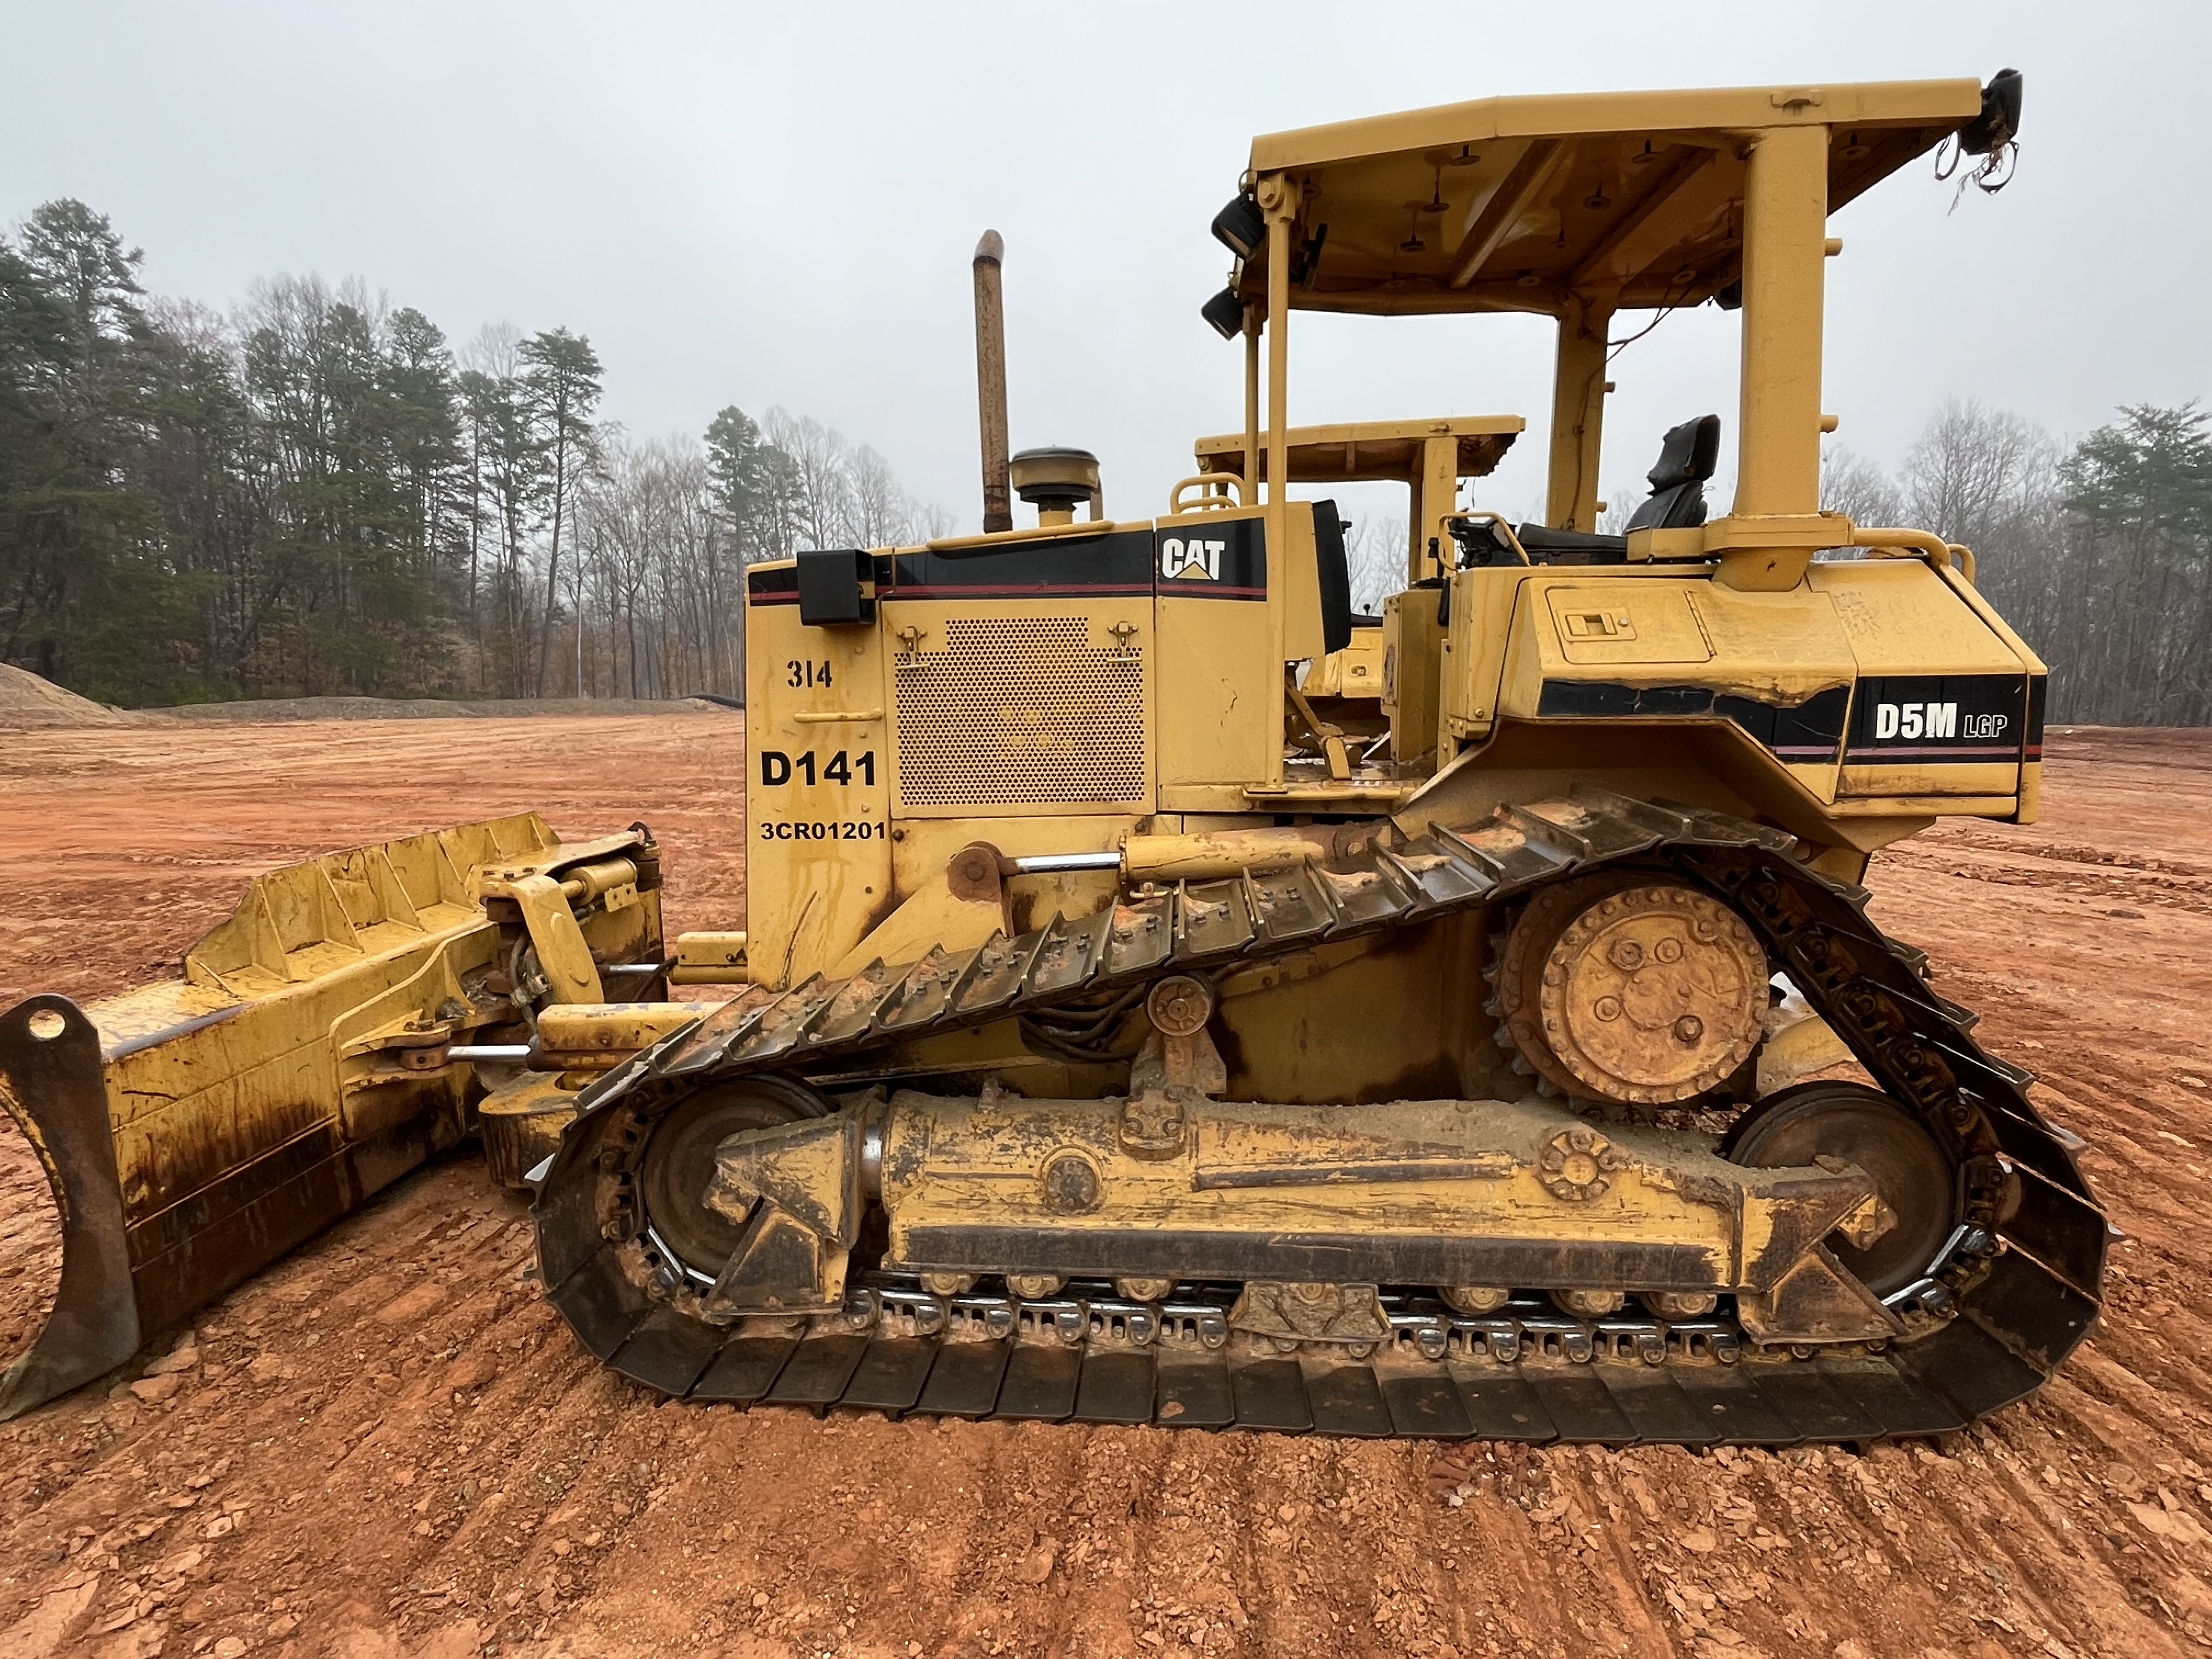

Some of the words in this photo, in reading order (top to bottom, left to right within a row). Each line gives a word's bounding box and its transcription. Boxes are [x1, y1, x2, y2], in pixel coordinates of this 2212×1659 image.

[1162, 538, 1225, 580] CAT
[787, 659, 833, 688] 314
[1875, 703, 1957, 739] D5M
[1963, 714, 2008, 738] LGP
[761, 751, 874, 786] D141
[760, 822, 884, 839] 3CR01201
